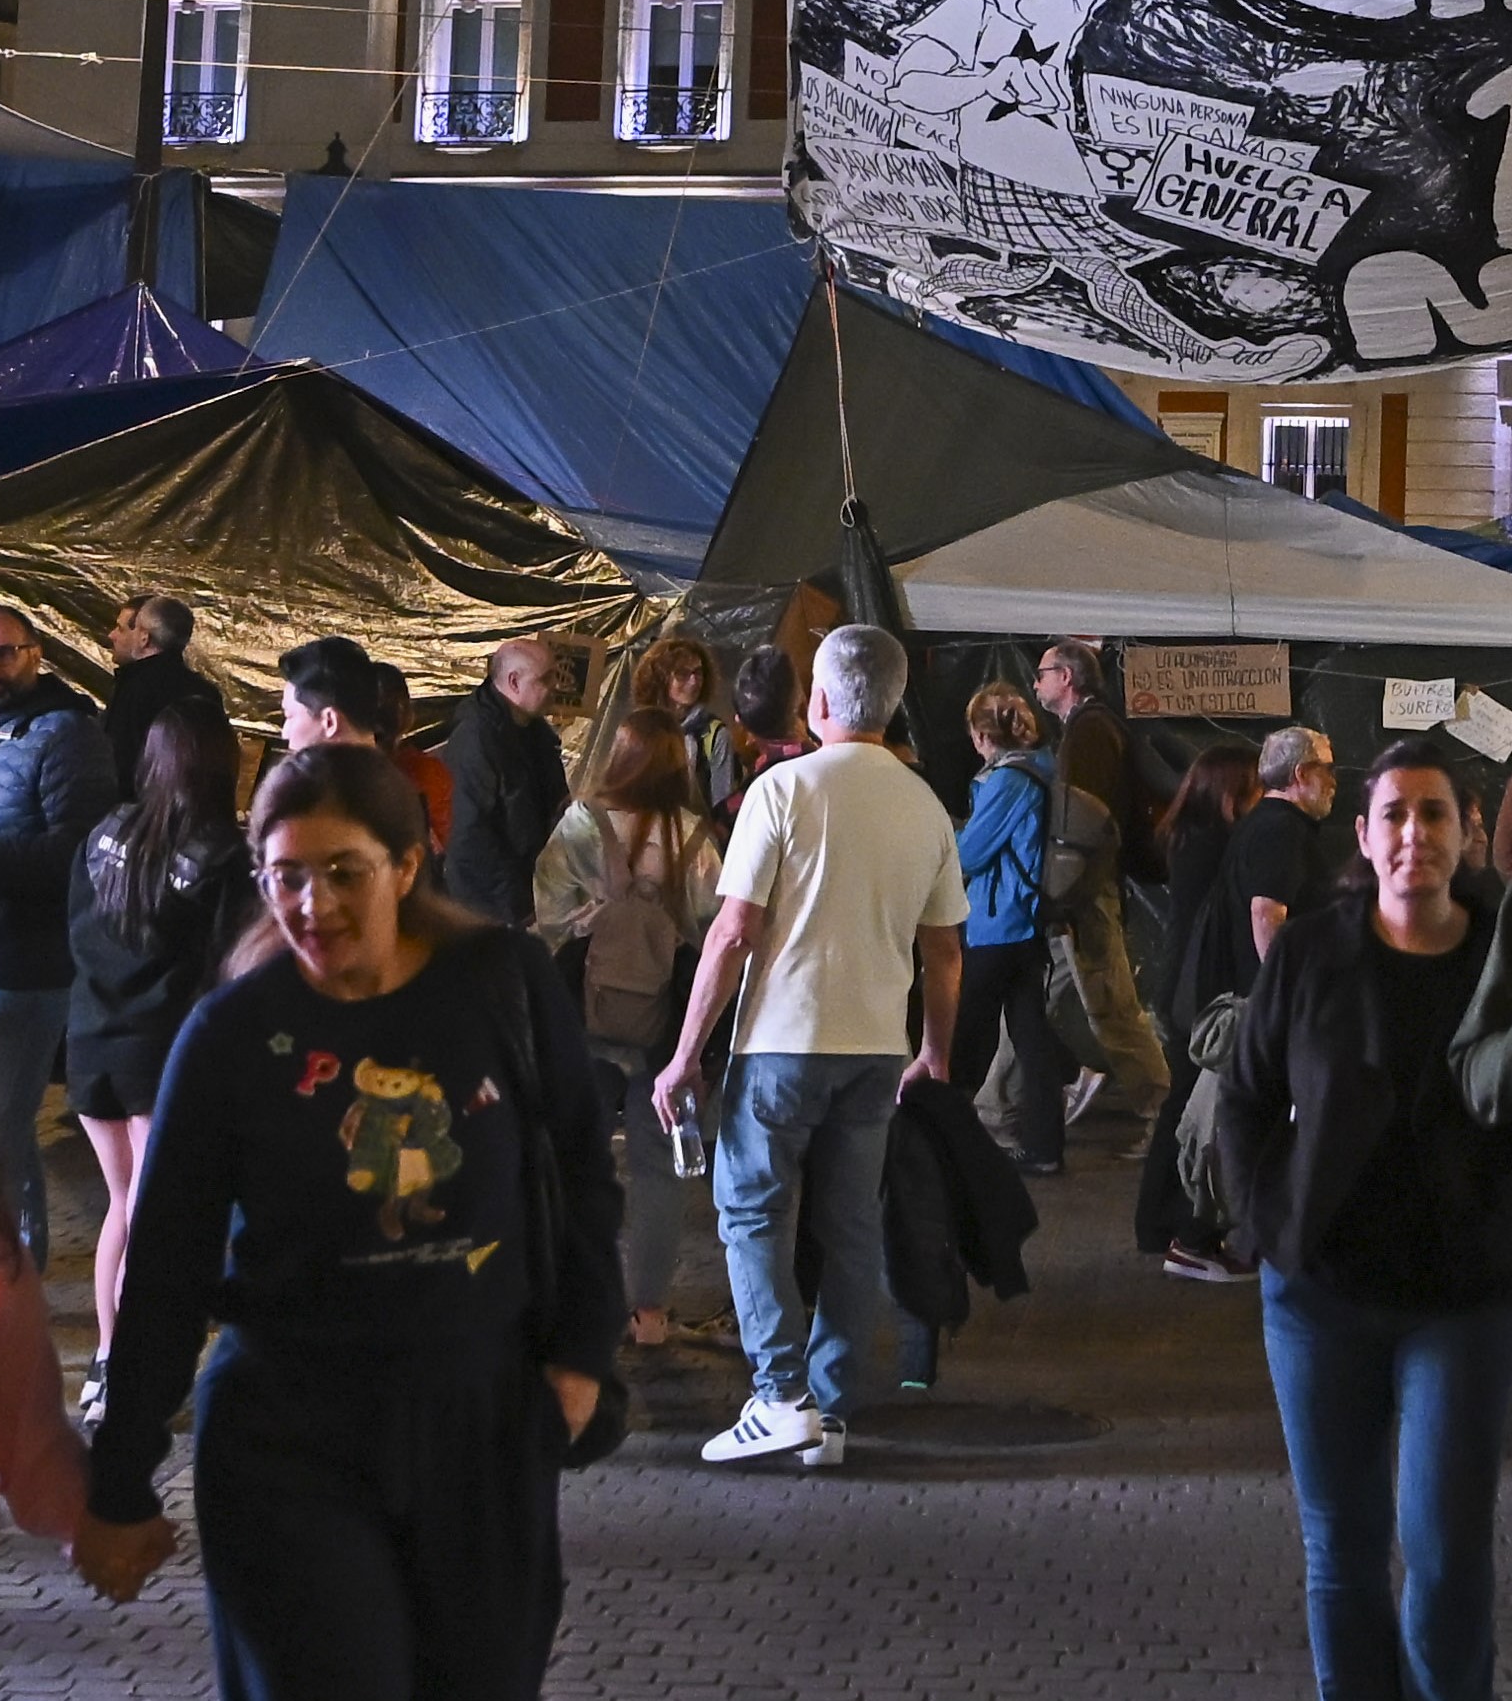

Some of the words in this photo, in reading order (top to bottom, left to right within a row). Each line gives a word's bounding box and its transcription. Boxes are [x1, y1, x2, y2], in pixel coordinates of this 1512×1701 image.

[855, 55, 889, 86] NO
[1100, 84, 1185, 116] NINGUNA
[1190, 101, 1248, 129] PERSONA
[1112, 111, 1141, 135] ES
[902, 112, 958, 152] PEACE
[1184, 142, 1352, 219] HUELGA
[1155, 173, 1323, 253] GENERAL
[1157, 670, 1174, 691] ES
[1182, 670, 1209, 689] UNA
